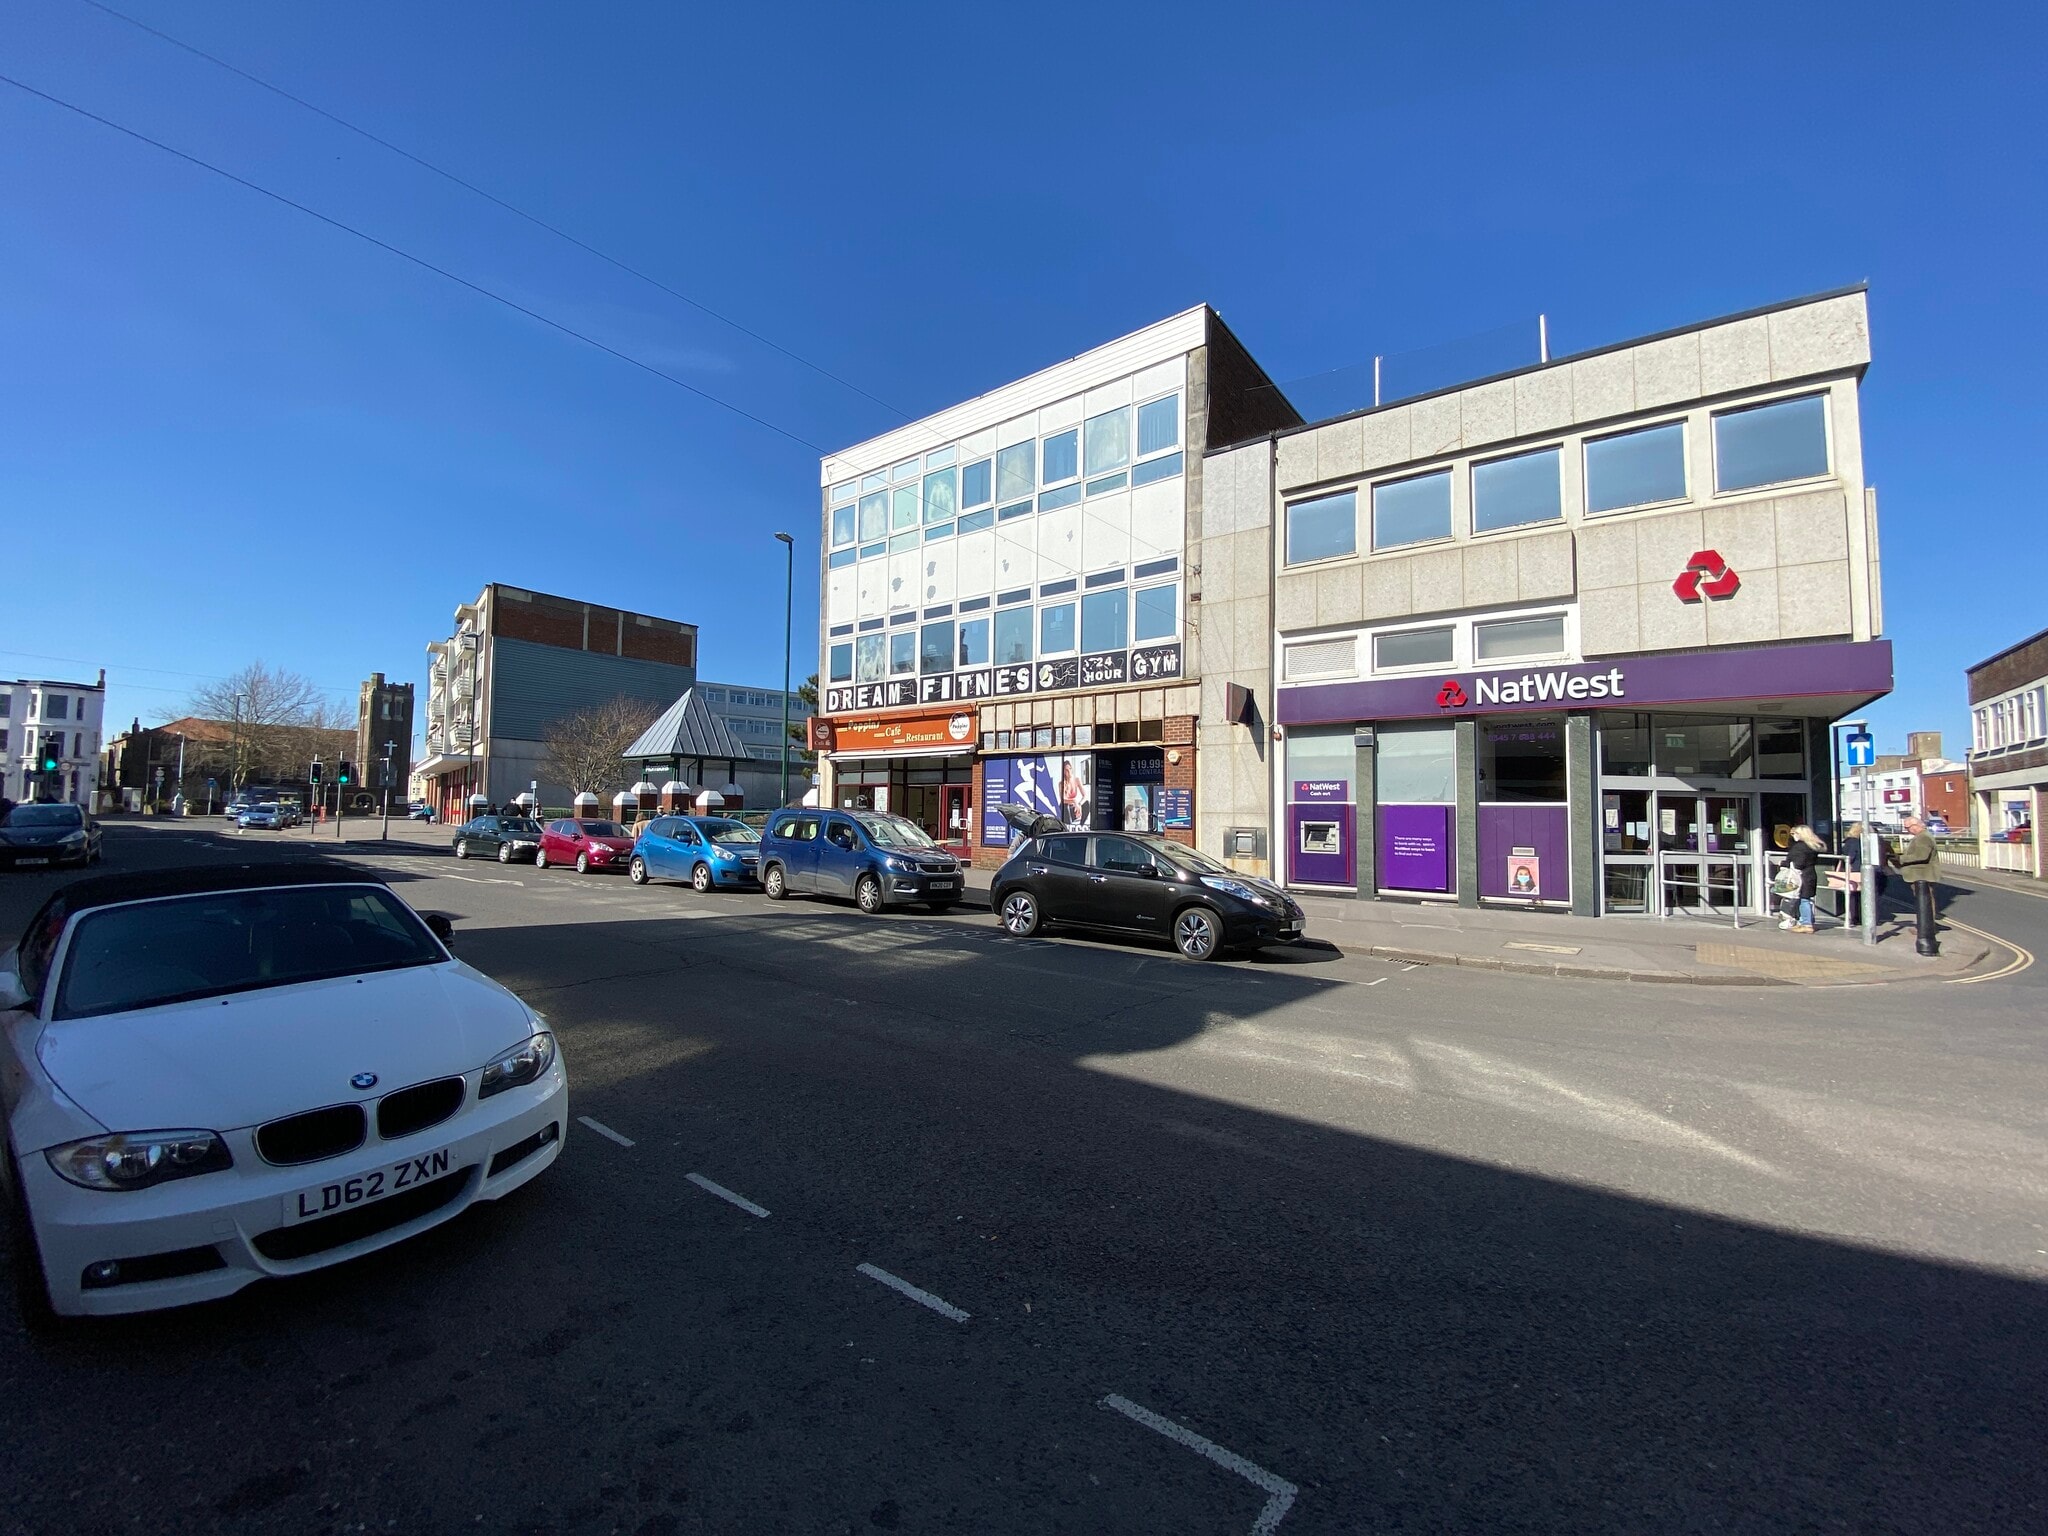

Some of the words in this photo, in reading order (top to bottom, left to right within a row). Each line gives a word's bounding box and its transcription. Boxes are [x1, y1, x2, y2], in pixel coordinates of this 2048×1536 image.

[1095, 656, 1112, 667] 24
[1133, 653, 1176, 675] GYM
[1087, 668, 1122, 682] HOUR
[828, 682, 900, 711] DREAM
[922, 664, 1054, 701] FITNESS
[1475, 667, 1624, 705] NatWest
[848, 719, 879, 733] Poppins
[885, 725, 901, 737] Café
[906, 732, 943, 742] Restaurant
[1130, 759, 1160, 770] £19.99
[298, 1171, 385, 1218] LD62
[394, 1148, 449, 1189] ZXN
